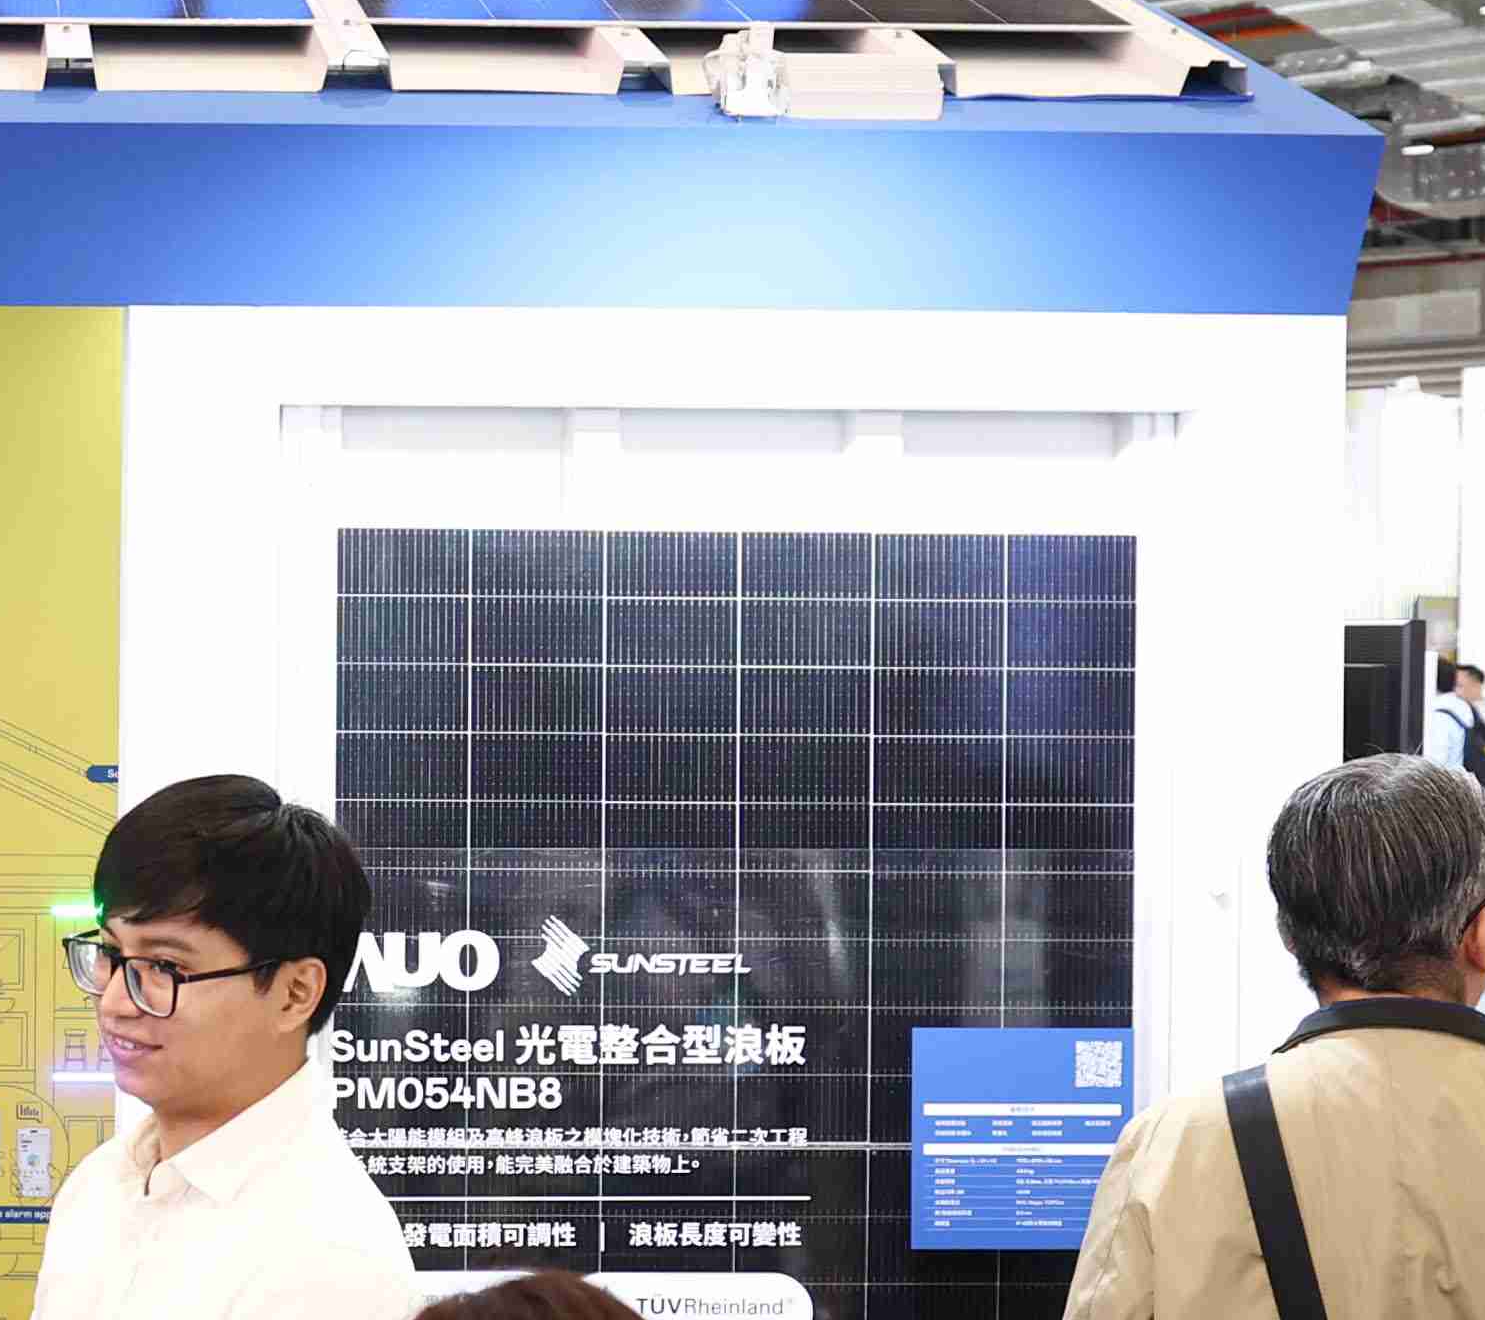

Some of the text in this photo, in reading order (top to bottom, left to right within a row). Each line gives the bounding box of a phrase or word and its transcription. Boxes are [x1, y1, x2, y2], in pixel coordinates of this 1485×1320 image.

[343, 930, 500, 992] AUO
[588, 953, 752, 975] SUNSTEEL
[330, 1024, 807, 1066] SunSteel 光電整合型浪板
[333, 1077, 563, 1110] PM054NB8
[5, 1208, 33, 1218] alarm
[403, 1221, 803, 1248] 發電面積可調性 浪板長度可變性
